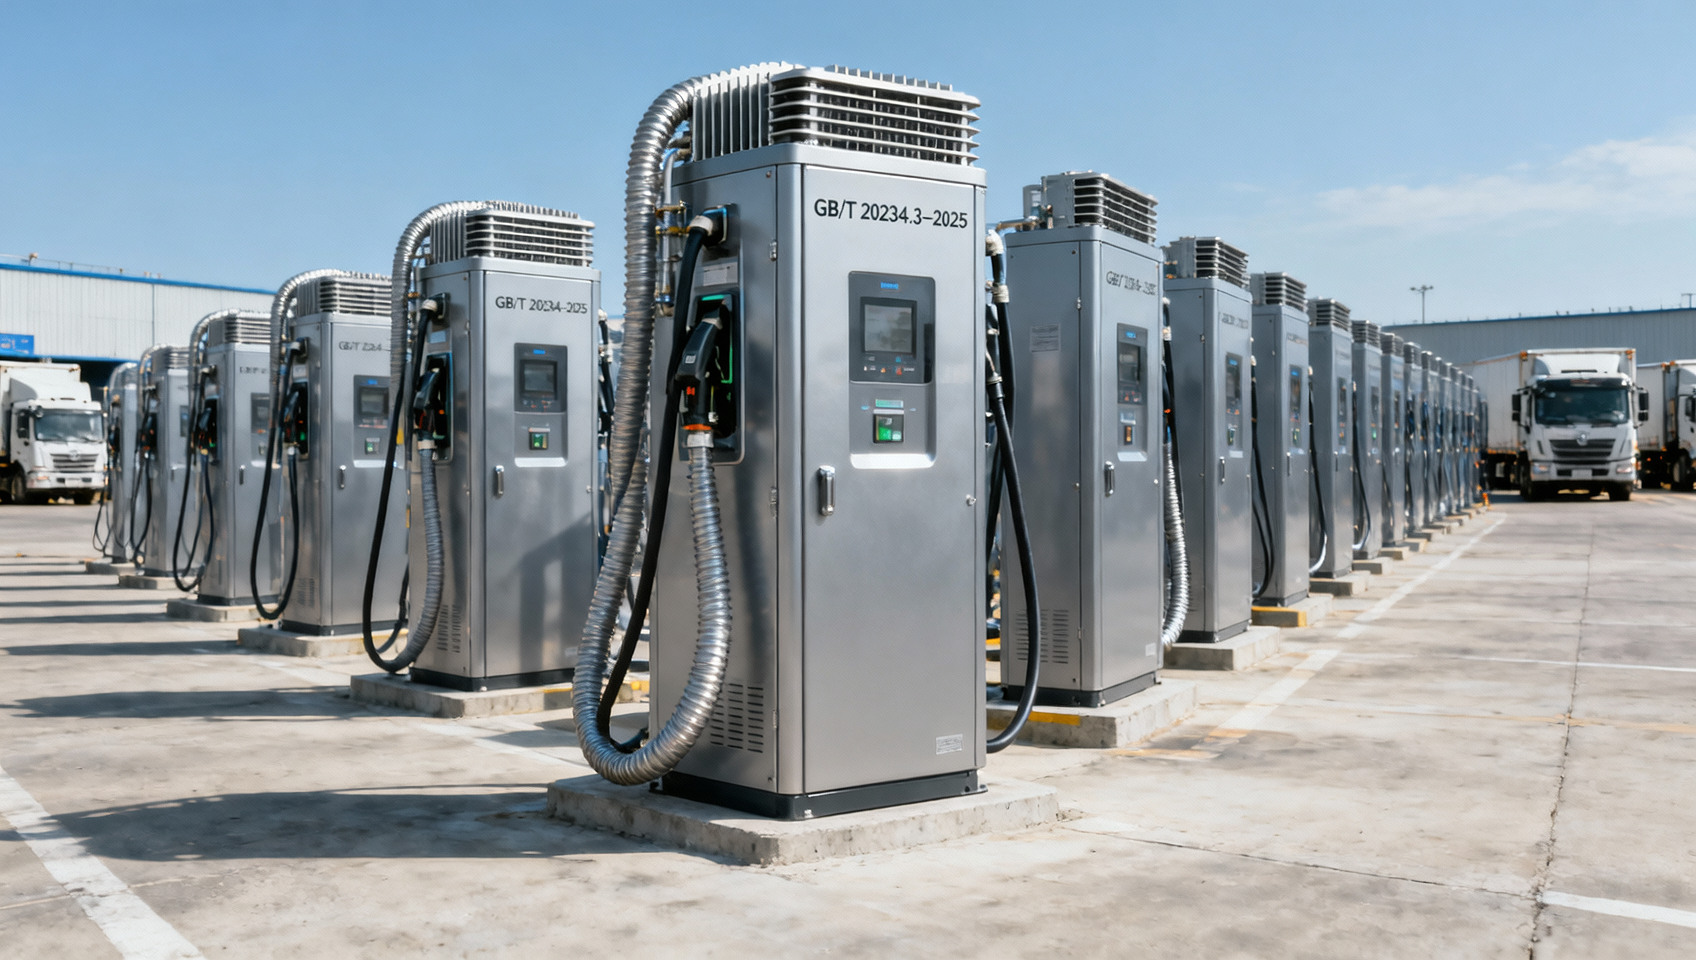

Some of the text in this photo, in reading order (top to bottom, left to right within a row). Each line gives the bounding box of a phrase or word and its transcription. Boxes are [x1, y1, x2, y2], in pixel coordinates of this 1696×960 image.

[814, 198, 968, 229] GB/T 20234.3-2025
[495, 295, 527, 310] GB/T
